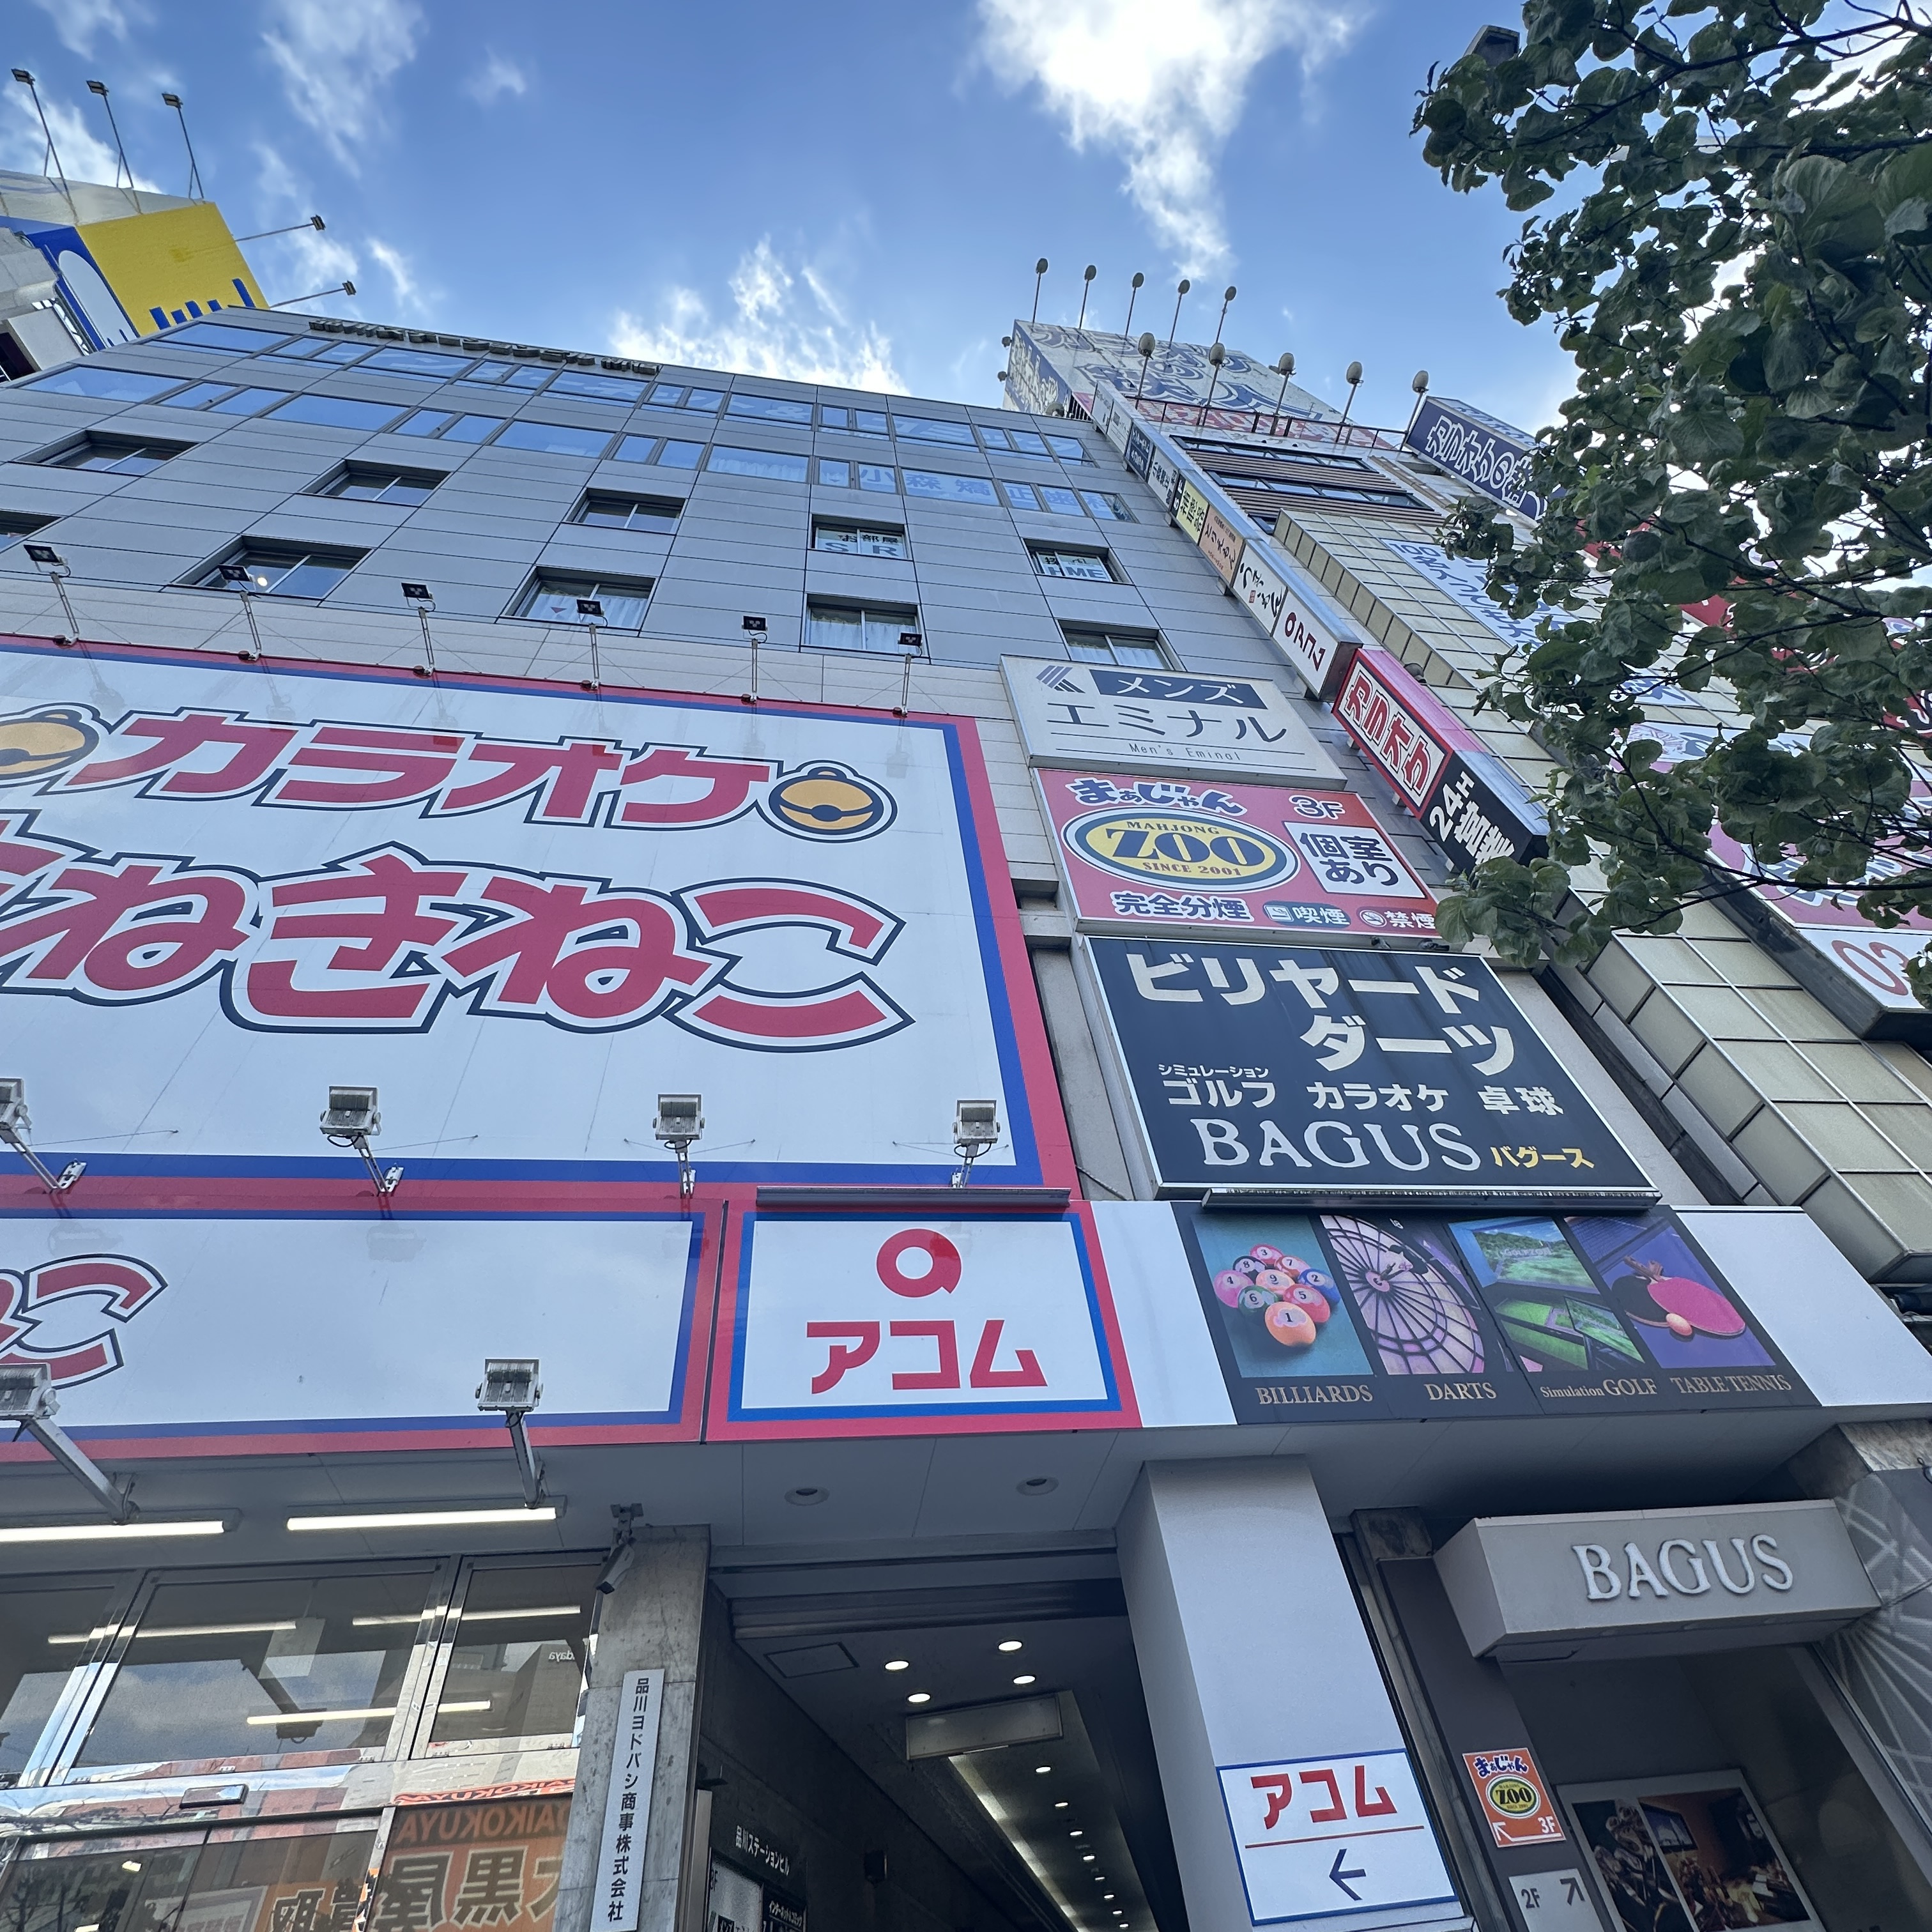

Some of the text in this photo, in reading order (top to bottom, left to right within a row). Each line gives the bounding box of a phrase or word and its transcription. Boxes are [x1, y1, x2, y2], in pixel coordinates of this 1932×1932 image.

[1116, 676, 1244, 704] メンズ
[1046, 702, 1287, 743] エミナル
[1343, 670, 1431, 796] カラオケ
[1129, 743, 1241, 762] Men's Eminal
[33, 707, 783, 830] カラオケ
[1066, 778, 1247, 816] まぁじゃん
[1289, 794, 1347, 820] 3F
[1429, 770, 1475, 842] 24H
[1126, 820, 1221, 835] MAHJONG
[1106, 827, 1267, 868] ZOO
[1300, 832, 1394, 862] 個室
[1142, 862, 1242, 877] SINCE 2001
[1320, 859, 1400, 887] あり
[1109, 891, 1254, 923] 完全分煙
[1292, 907, 1351, 925] 喫煙
[1384, 910, 1436, 930] 禁煙
[1126, 951, 1481, 1016] ビリヤード
[1300, 1014, 1515, 1076] ダーツ
[1158, 1062, 1270, 1080] シミュレーション
[1161, 1078, 1565, 1117] ゴルフ カラオケ 卓球
[1188, 1117, 1595, 1172] BAGUS バグース
[806, 1319, 1048, 1395] アコム
[1254, 1384, 1374, 1405] BILLIARDS
[1423, 1381, 1498, 1402] DARTS
[1539, 1377, 1659, 1399] Simulation GOLF
[1669, 1374, 1793, 1394] TABLE TENNIS
[1570, 1533, 1795, 1601] BAGUS
[1473, 1754, 1529, 1779] まぁじゃん
[607, 1677, 650, 1922] 品川ヨドバシ商事株式会社
[1250, 1765, 1398, 1830] アコム
[1495, 1787, 1533, 1805] ZOO
[1537, 1816, 1556, 1834] 3F
[1521, 1887, 1540, 1910] 2F
